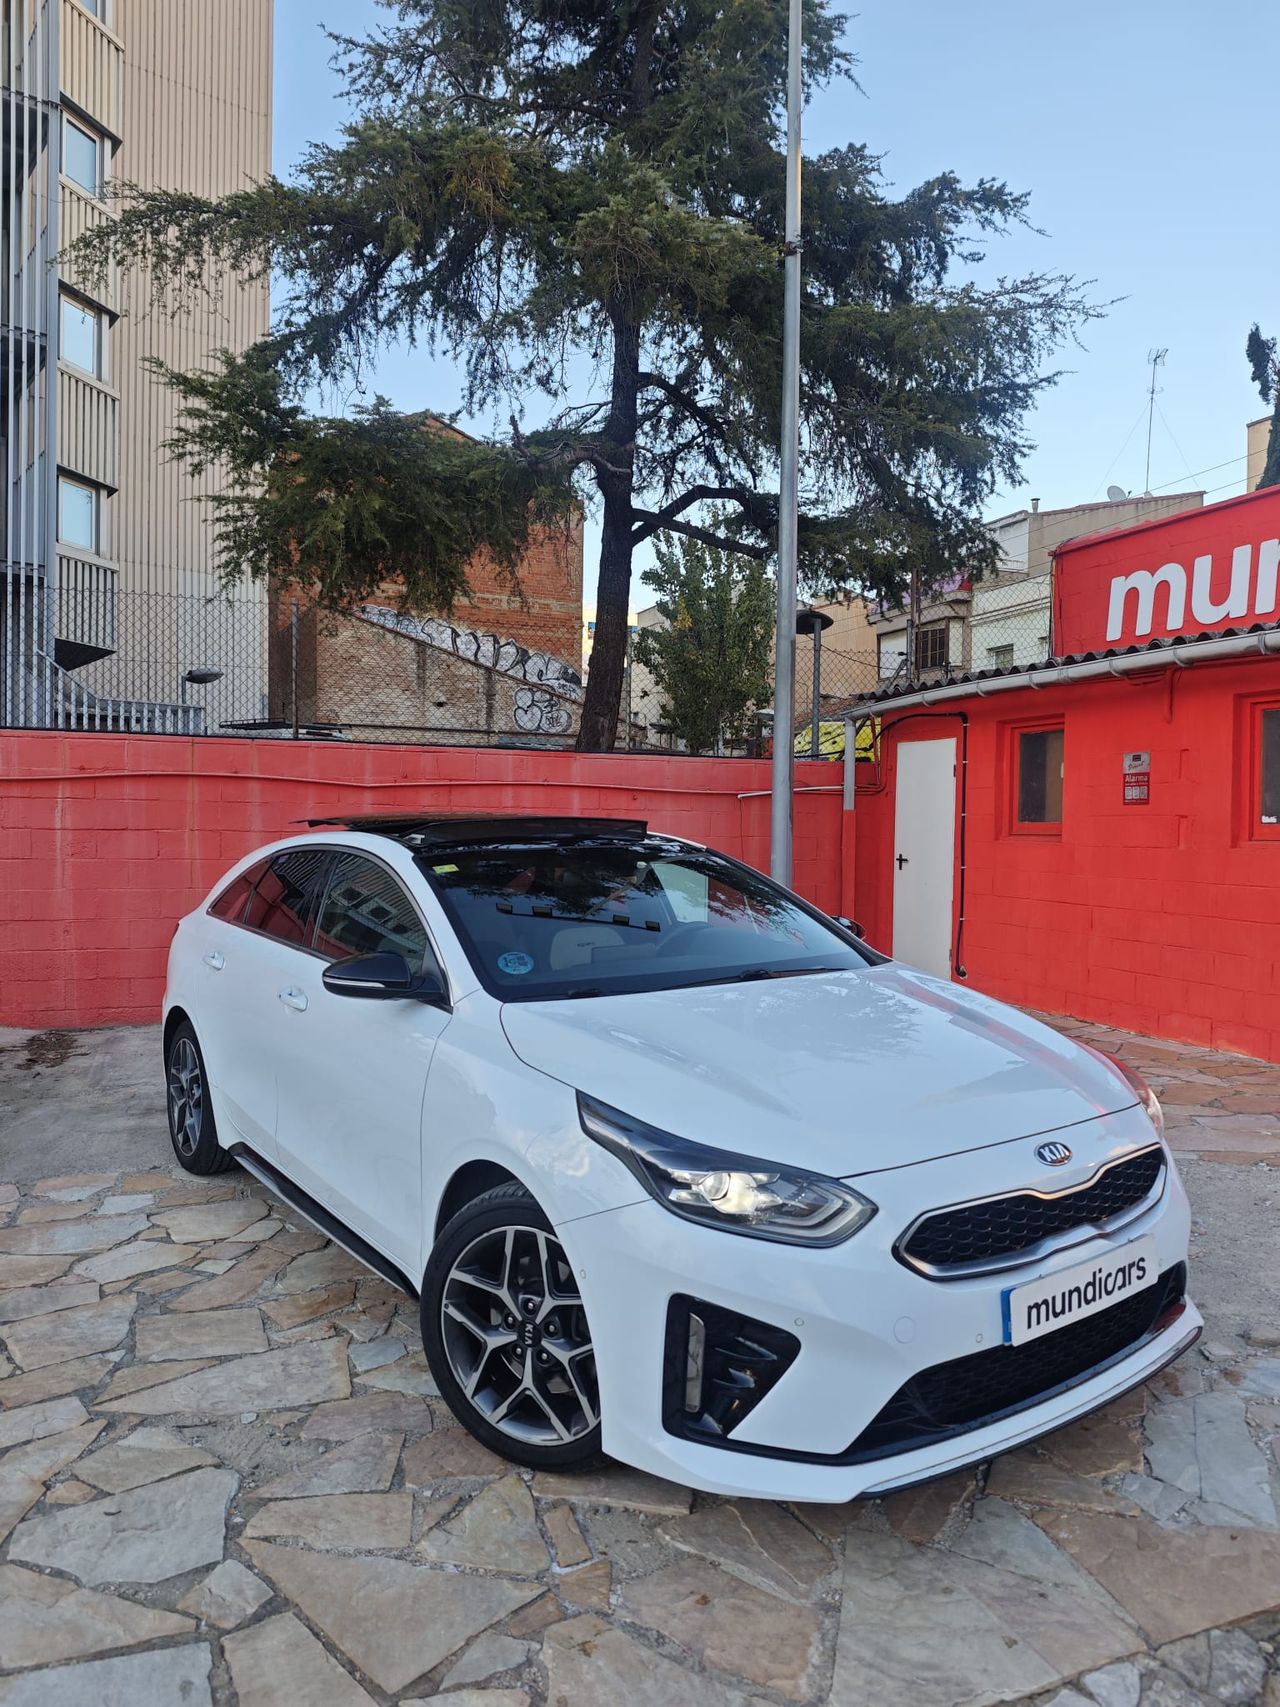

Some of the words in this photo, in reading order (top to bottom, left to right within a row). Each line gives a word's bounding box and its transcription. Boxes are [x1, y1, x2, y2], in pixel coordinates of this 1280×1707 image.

[1125, 774, 1149, 783] Alarma
[1039, 1143, 1070, 1162] KIA
[1026, 1256, 1147, 1330] mundicars
[524, 1323, 534, 1345] KIA
